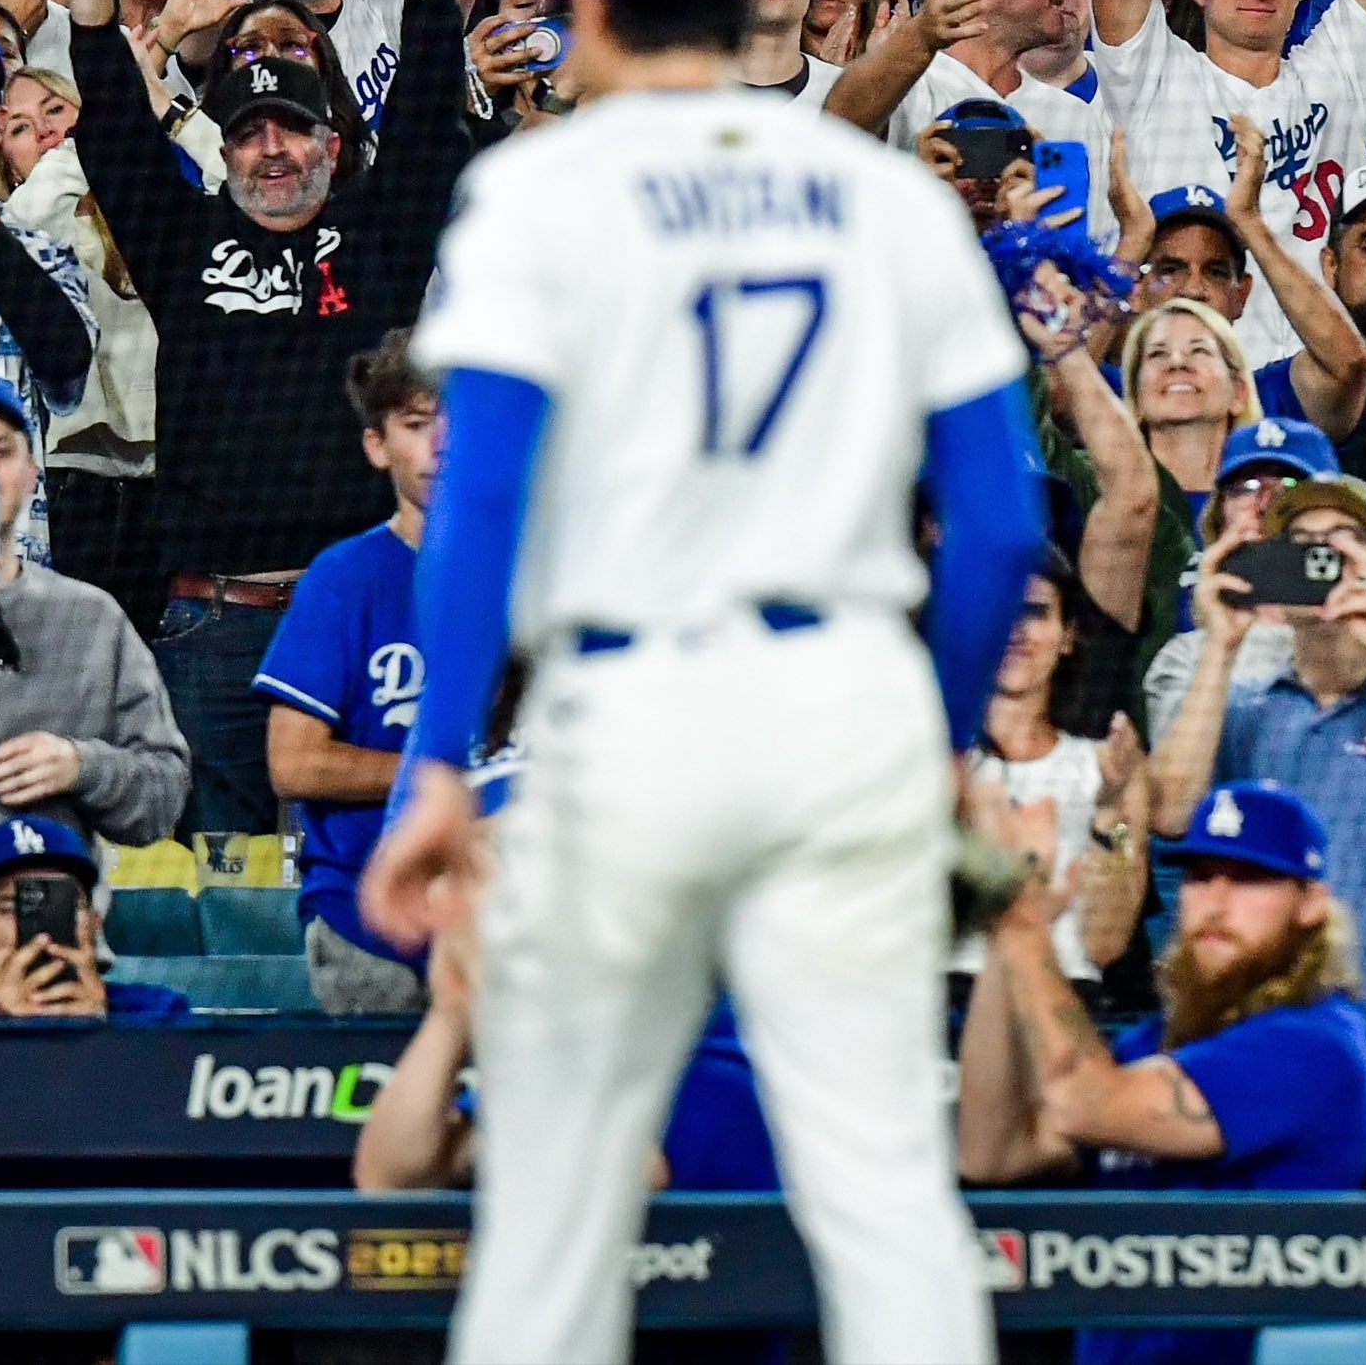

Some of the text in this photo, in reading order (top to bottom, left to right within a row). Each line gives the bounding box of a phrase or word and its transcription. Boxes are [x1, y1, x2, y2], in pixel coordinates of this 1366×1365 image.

[251, 64, 277, 93] LA
[1213, 103, 1329, 189] Ddgers
[1292, 160, 1345, 242] 50
[689, 276, 829, 457] 17
[187, 1054, 395, 1121] loanD
[171, 1231, 339, 1290] NLCS
